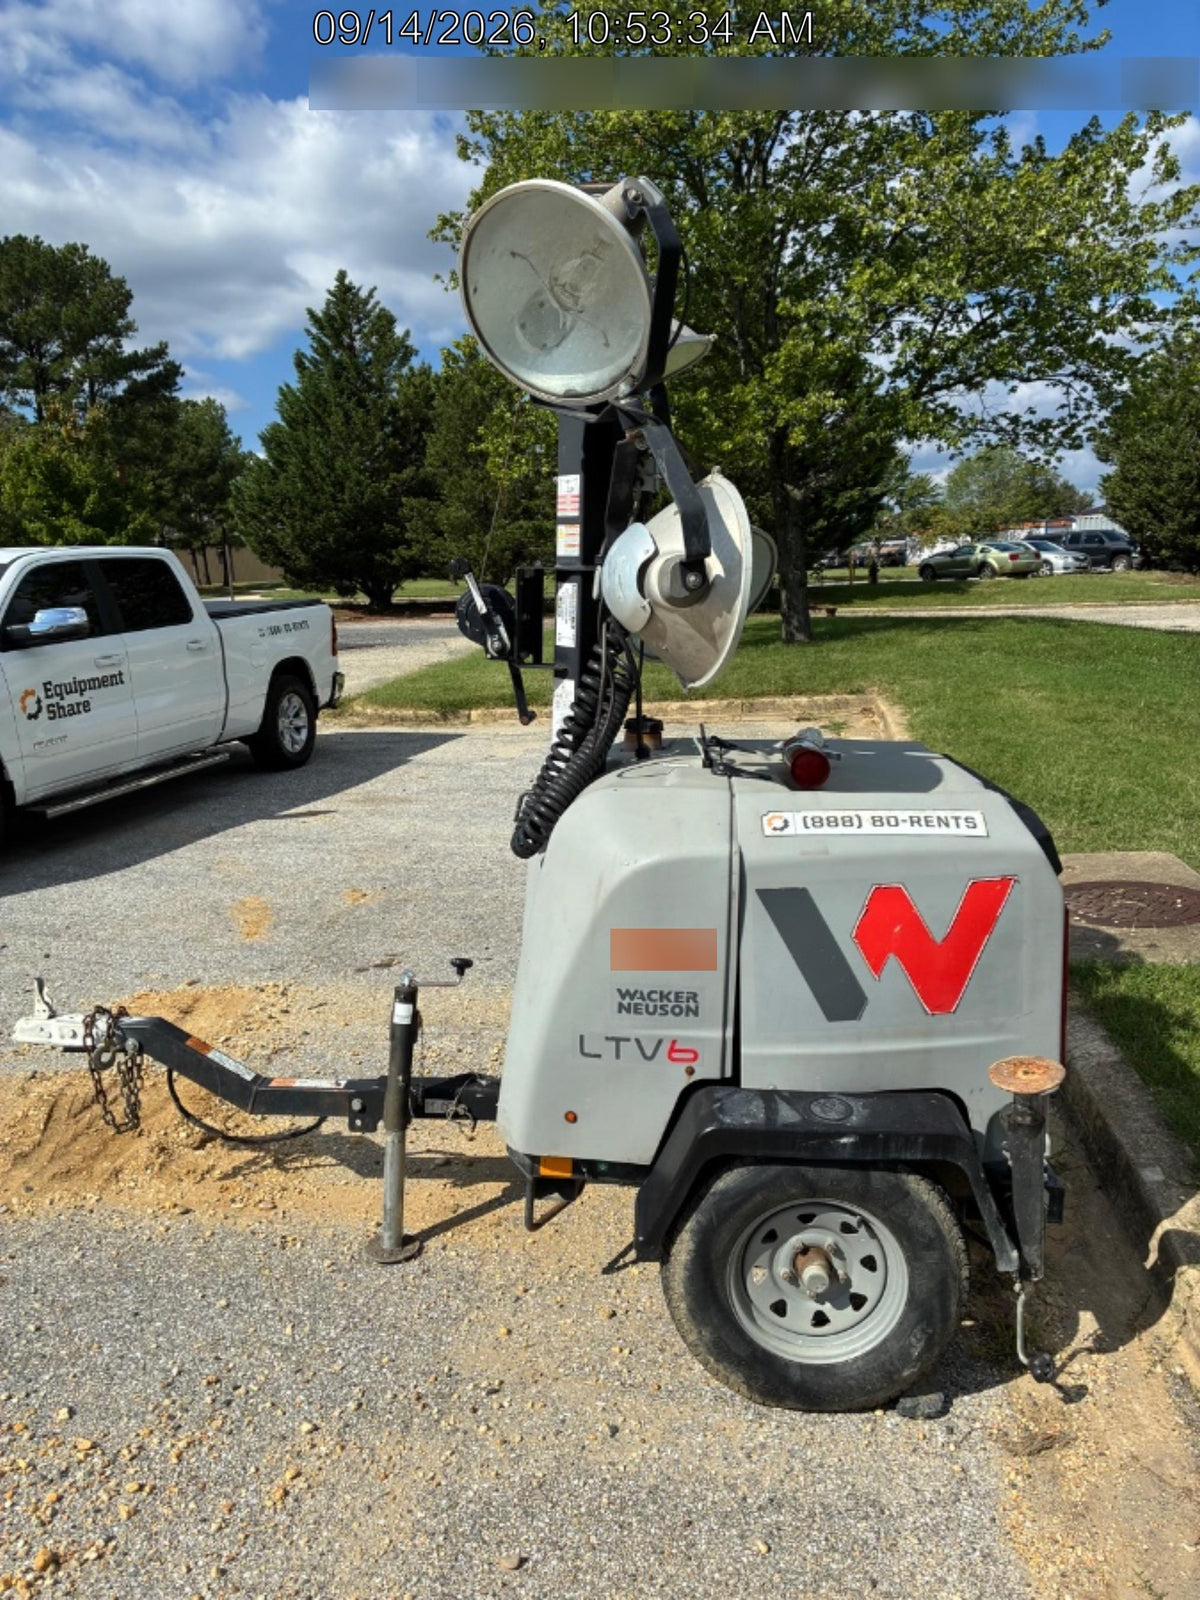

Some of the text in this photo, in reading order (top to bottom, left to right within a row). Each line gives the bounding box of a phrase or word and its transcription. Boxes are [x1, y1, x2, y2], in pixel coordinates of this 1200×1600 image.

[42, 670, 125, 701] Equipment
[46, 699, 92, 721] Share
[802, 815, 978, 829] (888) 80-RENTS
[616, 987, 699, 1003] WACKER
[616, 1001, 700, 1017] NEUSON
[579, 1034, 699, 1063] LTV6
